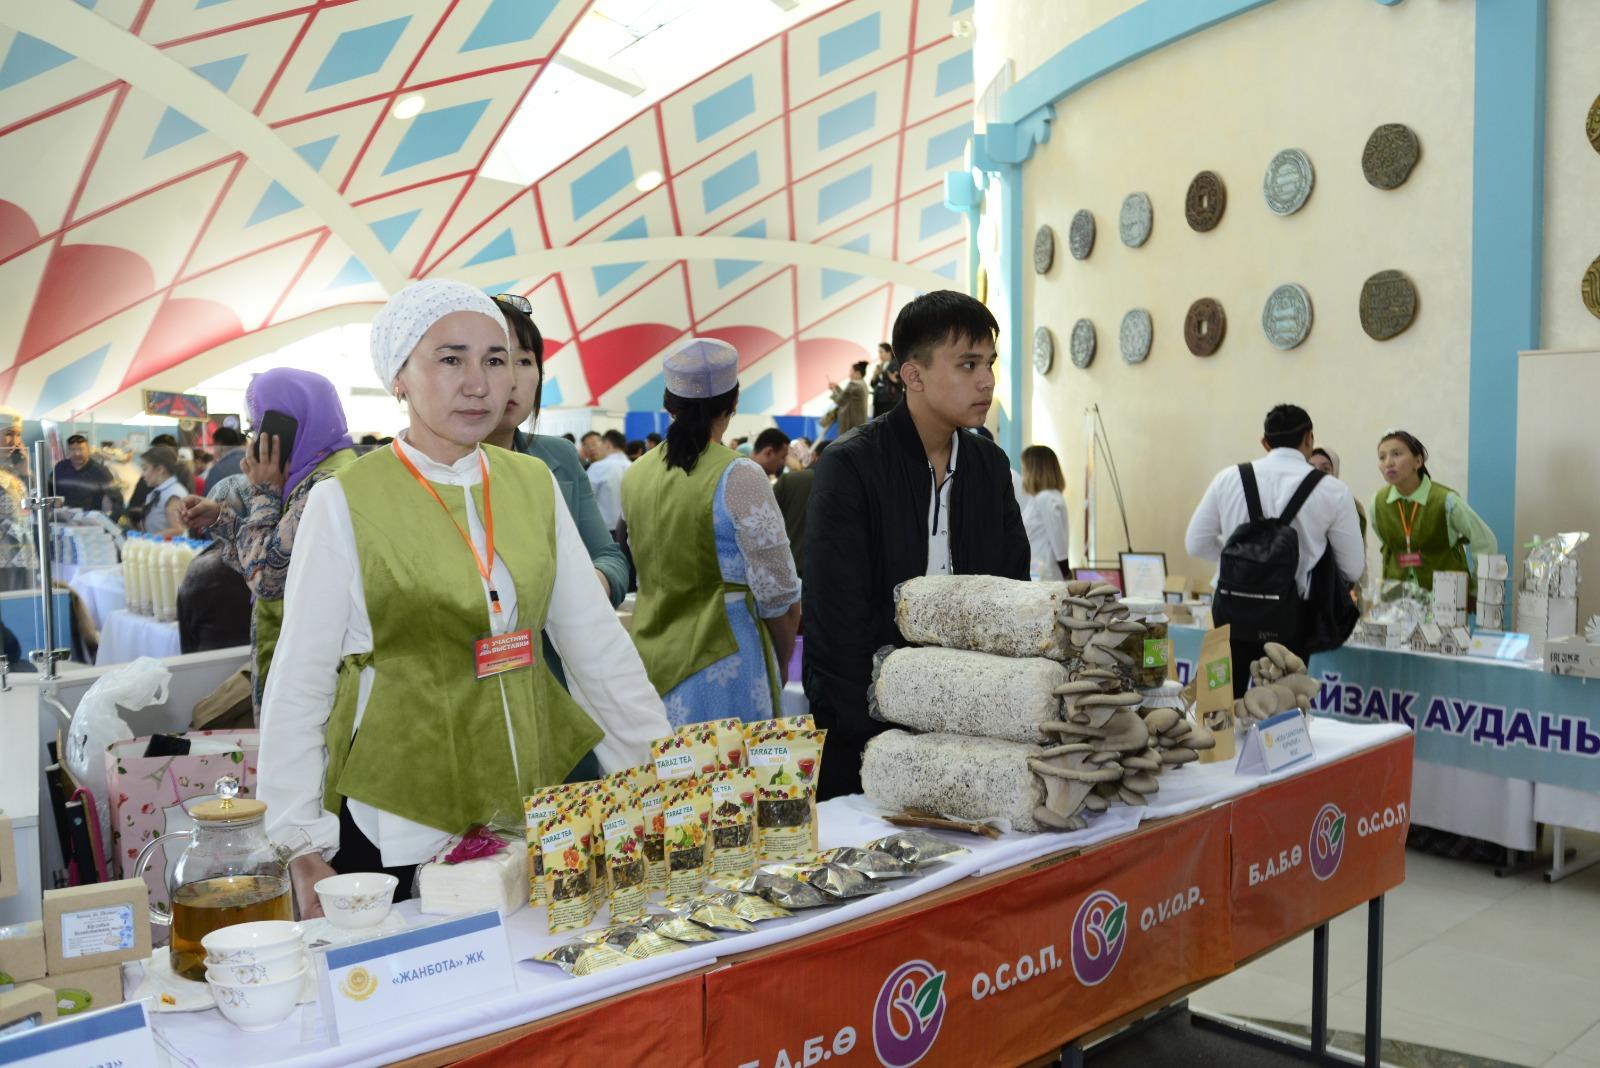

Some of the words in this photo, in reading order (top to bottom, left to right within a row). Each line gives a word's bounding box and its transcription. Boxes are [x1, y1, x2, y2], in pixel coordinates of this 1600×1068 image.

[1309, 674, 1415, 730] ЙЗАҚ
[750, 748, 773, 756] TARAZ
[773, 747, 788, 755] TEA
[656, 759, 678, 769] TARAZ
[678, 755, 693, 764] TEA
[528, 811, 547, 820] TARAZ
[666, 809, 683, 819] TARAZ
[683, 804, 693, 813] TEA
[604, 823, 617, 831] TARAZ
[617, 819, 627, 827] TEA
[542, 834, 561, 845] TARAZ
[562, 829, 573, 839] TEA
[1140, 886, 1205, 932] O.V.O.P.
[391, 958, 464, 985] «ЖАНБОТА»
[465, 950, 486, 966] ЖК
[970, 944, 1063, 1001] О.С.О.П.
